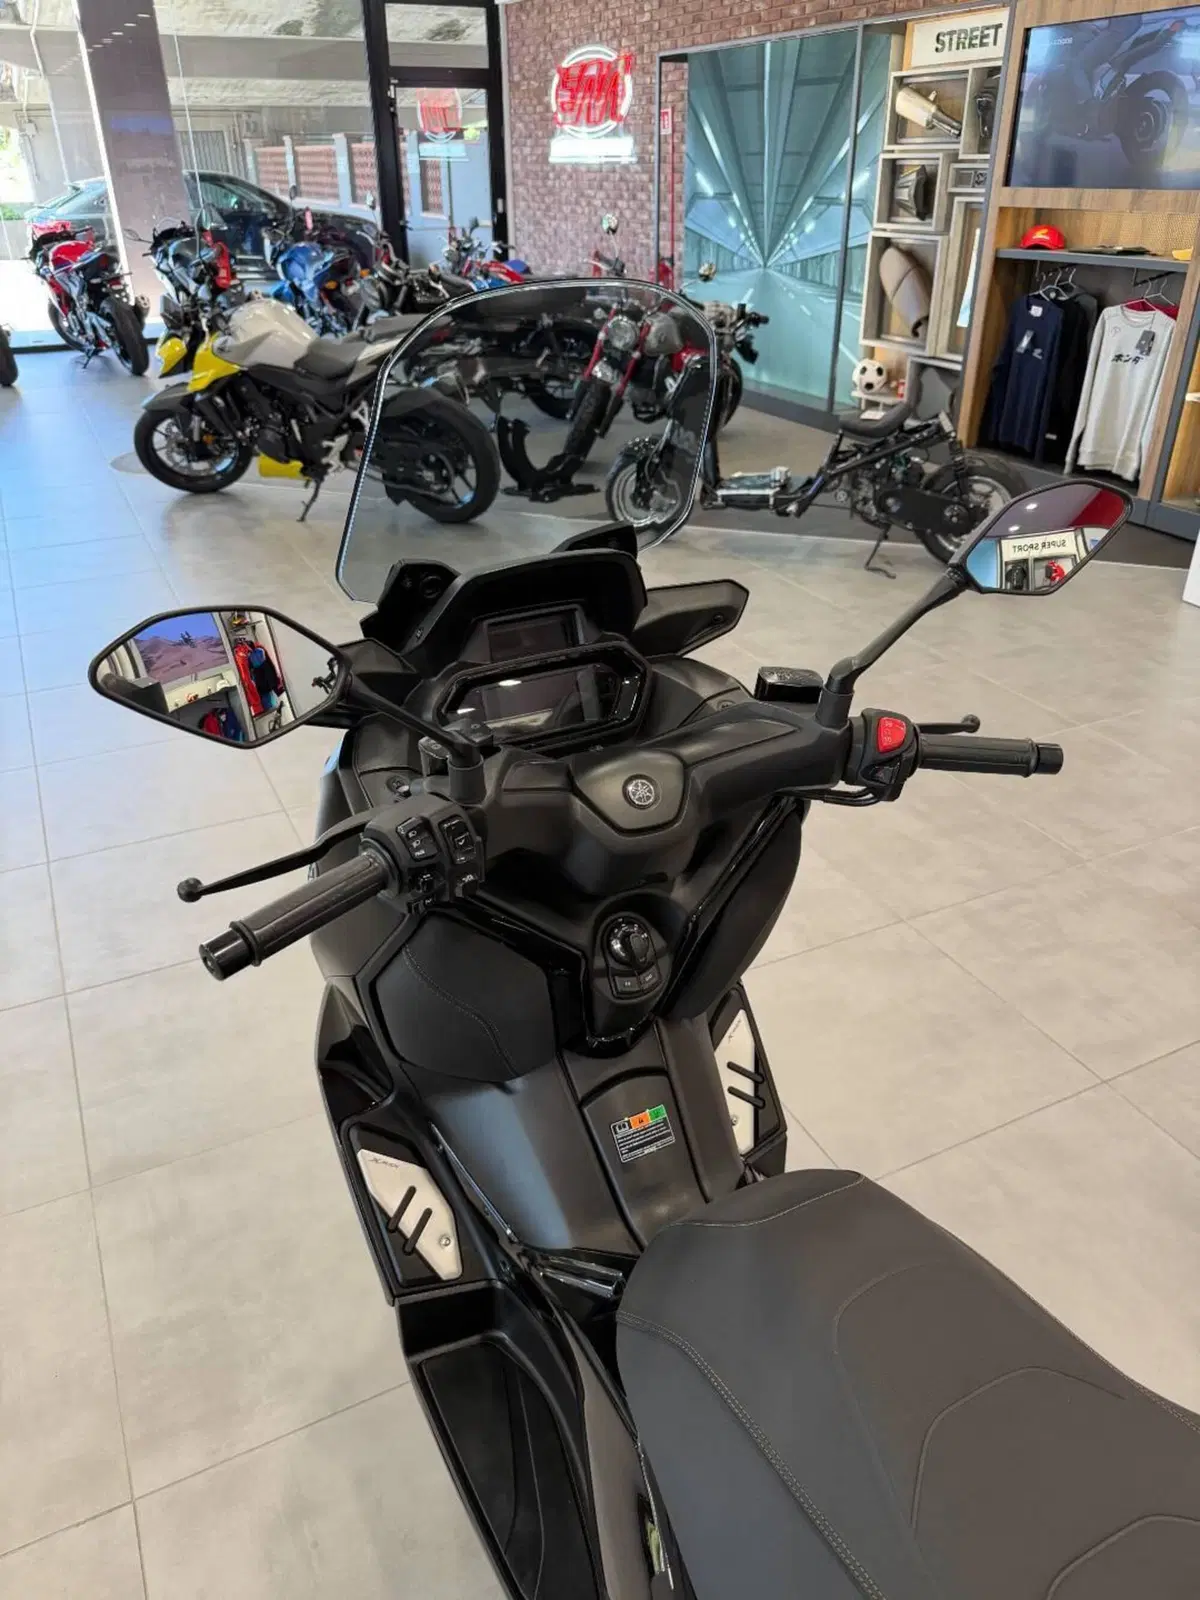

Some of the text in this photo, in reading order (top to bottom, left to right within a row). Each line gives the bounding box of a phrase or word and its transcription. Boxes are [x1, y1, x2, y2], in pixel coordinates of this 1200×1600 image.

[935, 23, 1003, 53] STREET
[1111, 354, 1144, 365] ホンダ
